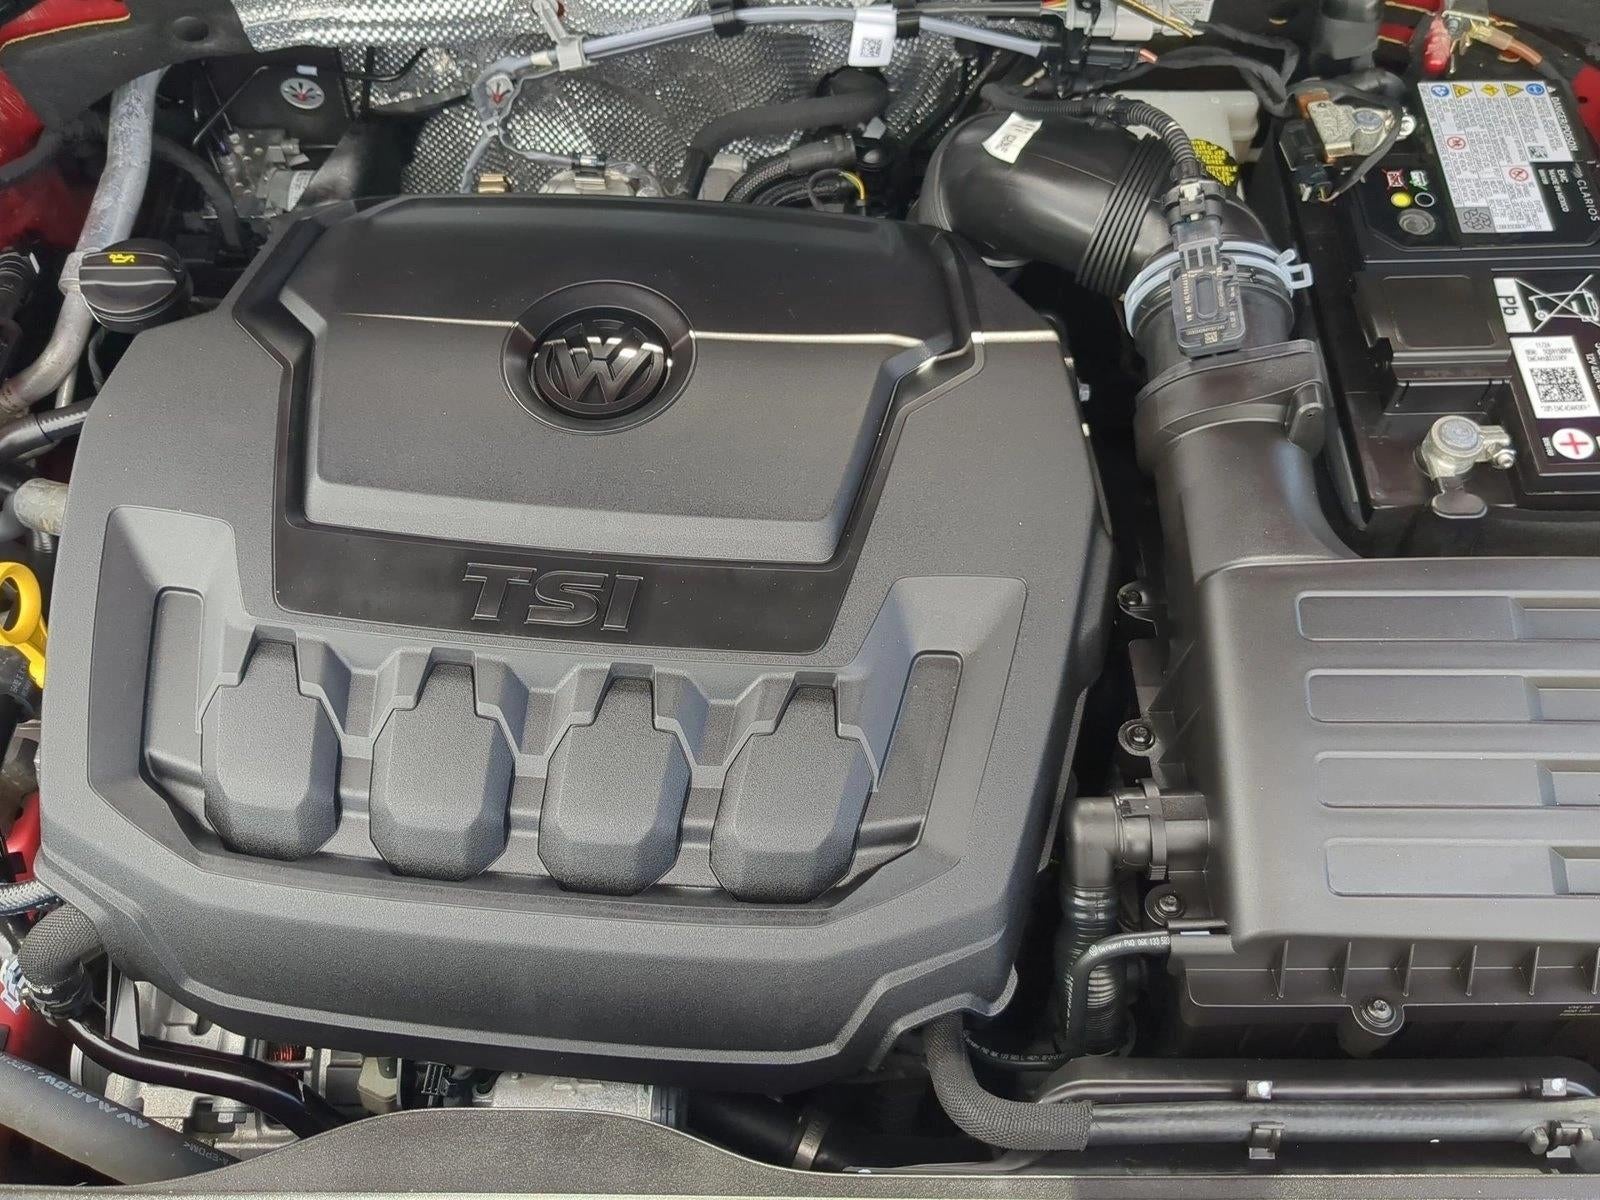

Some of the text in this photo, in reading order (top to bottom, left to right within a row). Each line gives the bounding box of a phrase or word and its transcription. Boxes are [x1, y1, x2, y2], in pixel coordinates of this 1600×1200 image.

[1577, 179, 1600, 222] CLARIOS
[1497, 295, 1518, 316] Pb
[462, 562, 643, 632] TSI
[1149, 937, 1159, 945] 133
